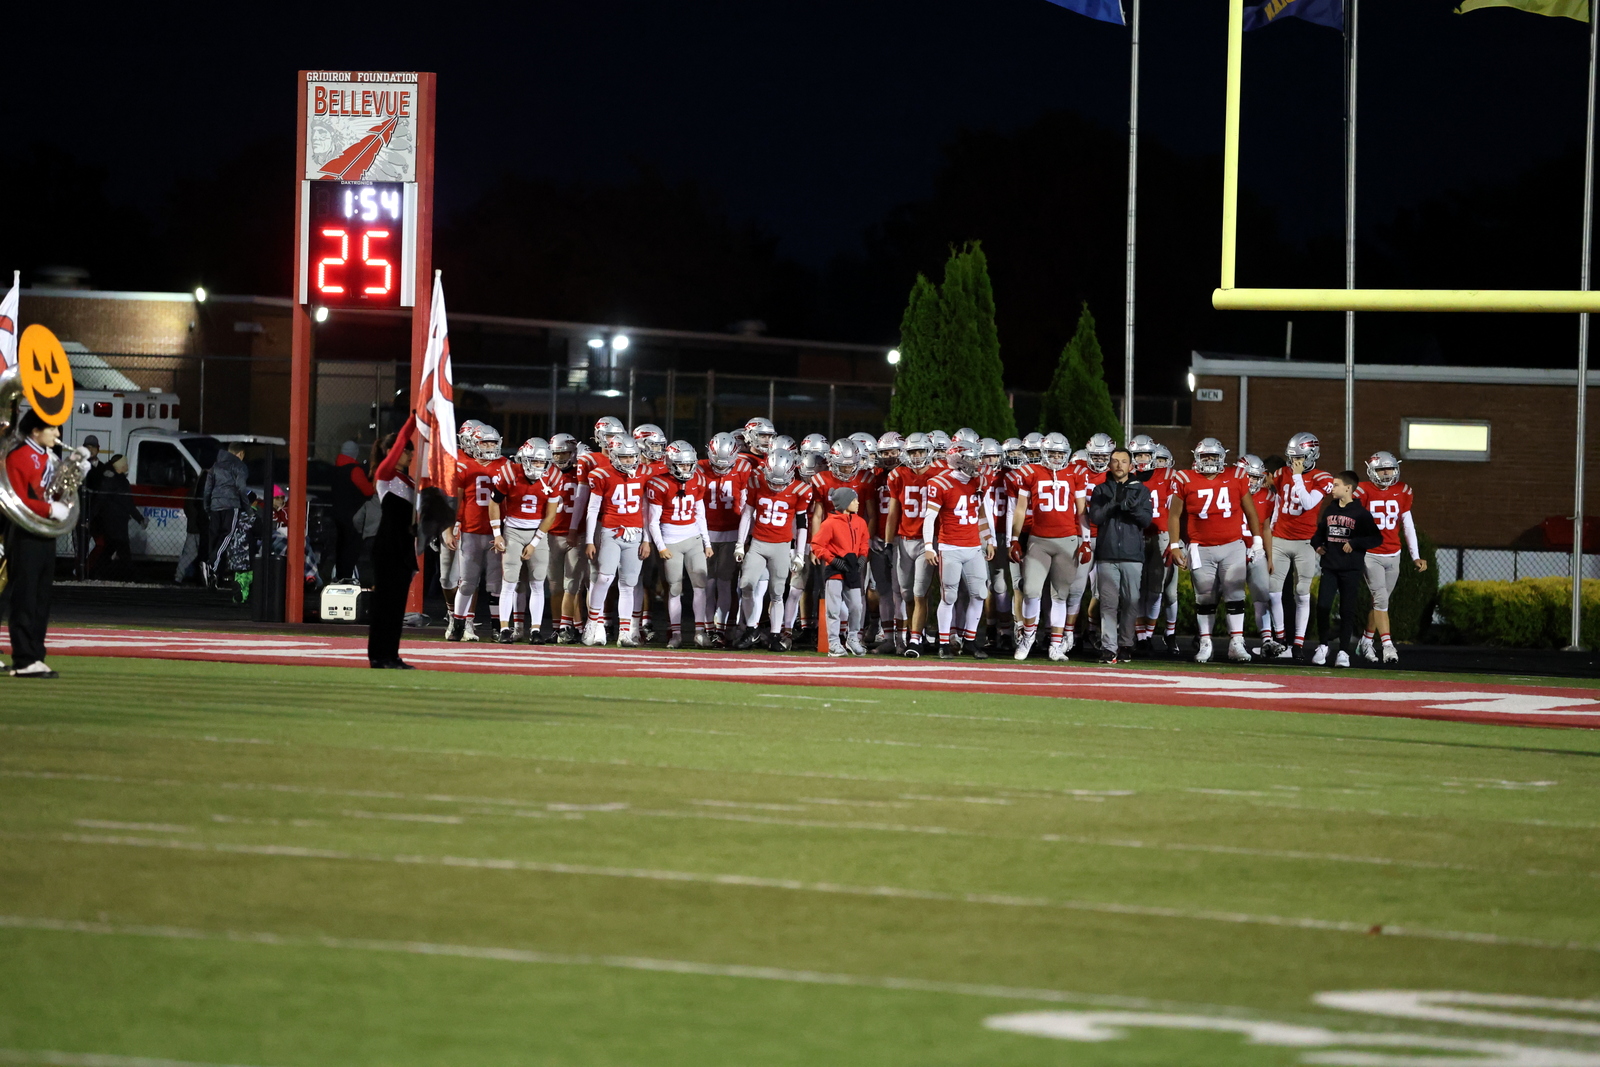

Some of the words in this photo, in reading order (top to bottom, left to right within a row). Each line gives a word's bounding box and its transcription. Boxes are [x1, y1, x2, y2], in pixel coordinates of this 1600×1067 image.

[306, 72, 351, 81] GRIDIRON
[357, 73, 418, 82] FOUNDATION
[314, 86, 410, 118] BELLEVUE
[344, 188, 398, 221] 1:54
[317, 229, 392, 294] 25
[1201, 390, 1219, 399] MEN
[521, 494, 538, 514] 2
[611, 482, 641, 514] 45
[670, 494, 695, 521] 10
[708, 480, 734, 510] 14
[904, 485, 929, 518] 51
[953, 494, 980, 525] 43
[1037, 479, 1070, 512] 50
[1197, 486, 1232, 519] 74
[143, 507, 180, 519] MEDIC
[157, 518, 167, 527] 71
[758, 497, 789, 527] 36
[1369, 499, 1400, 530] 58
